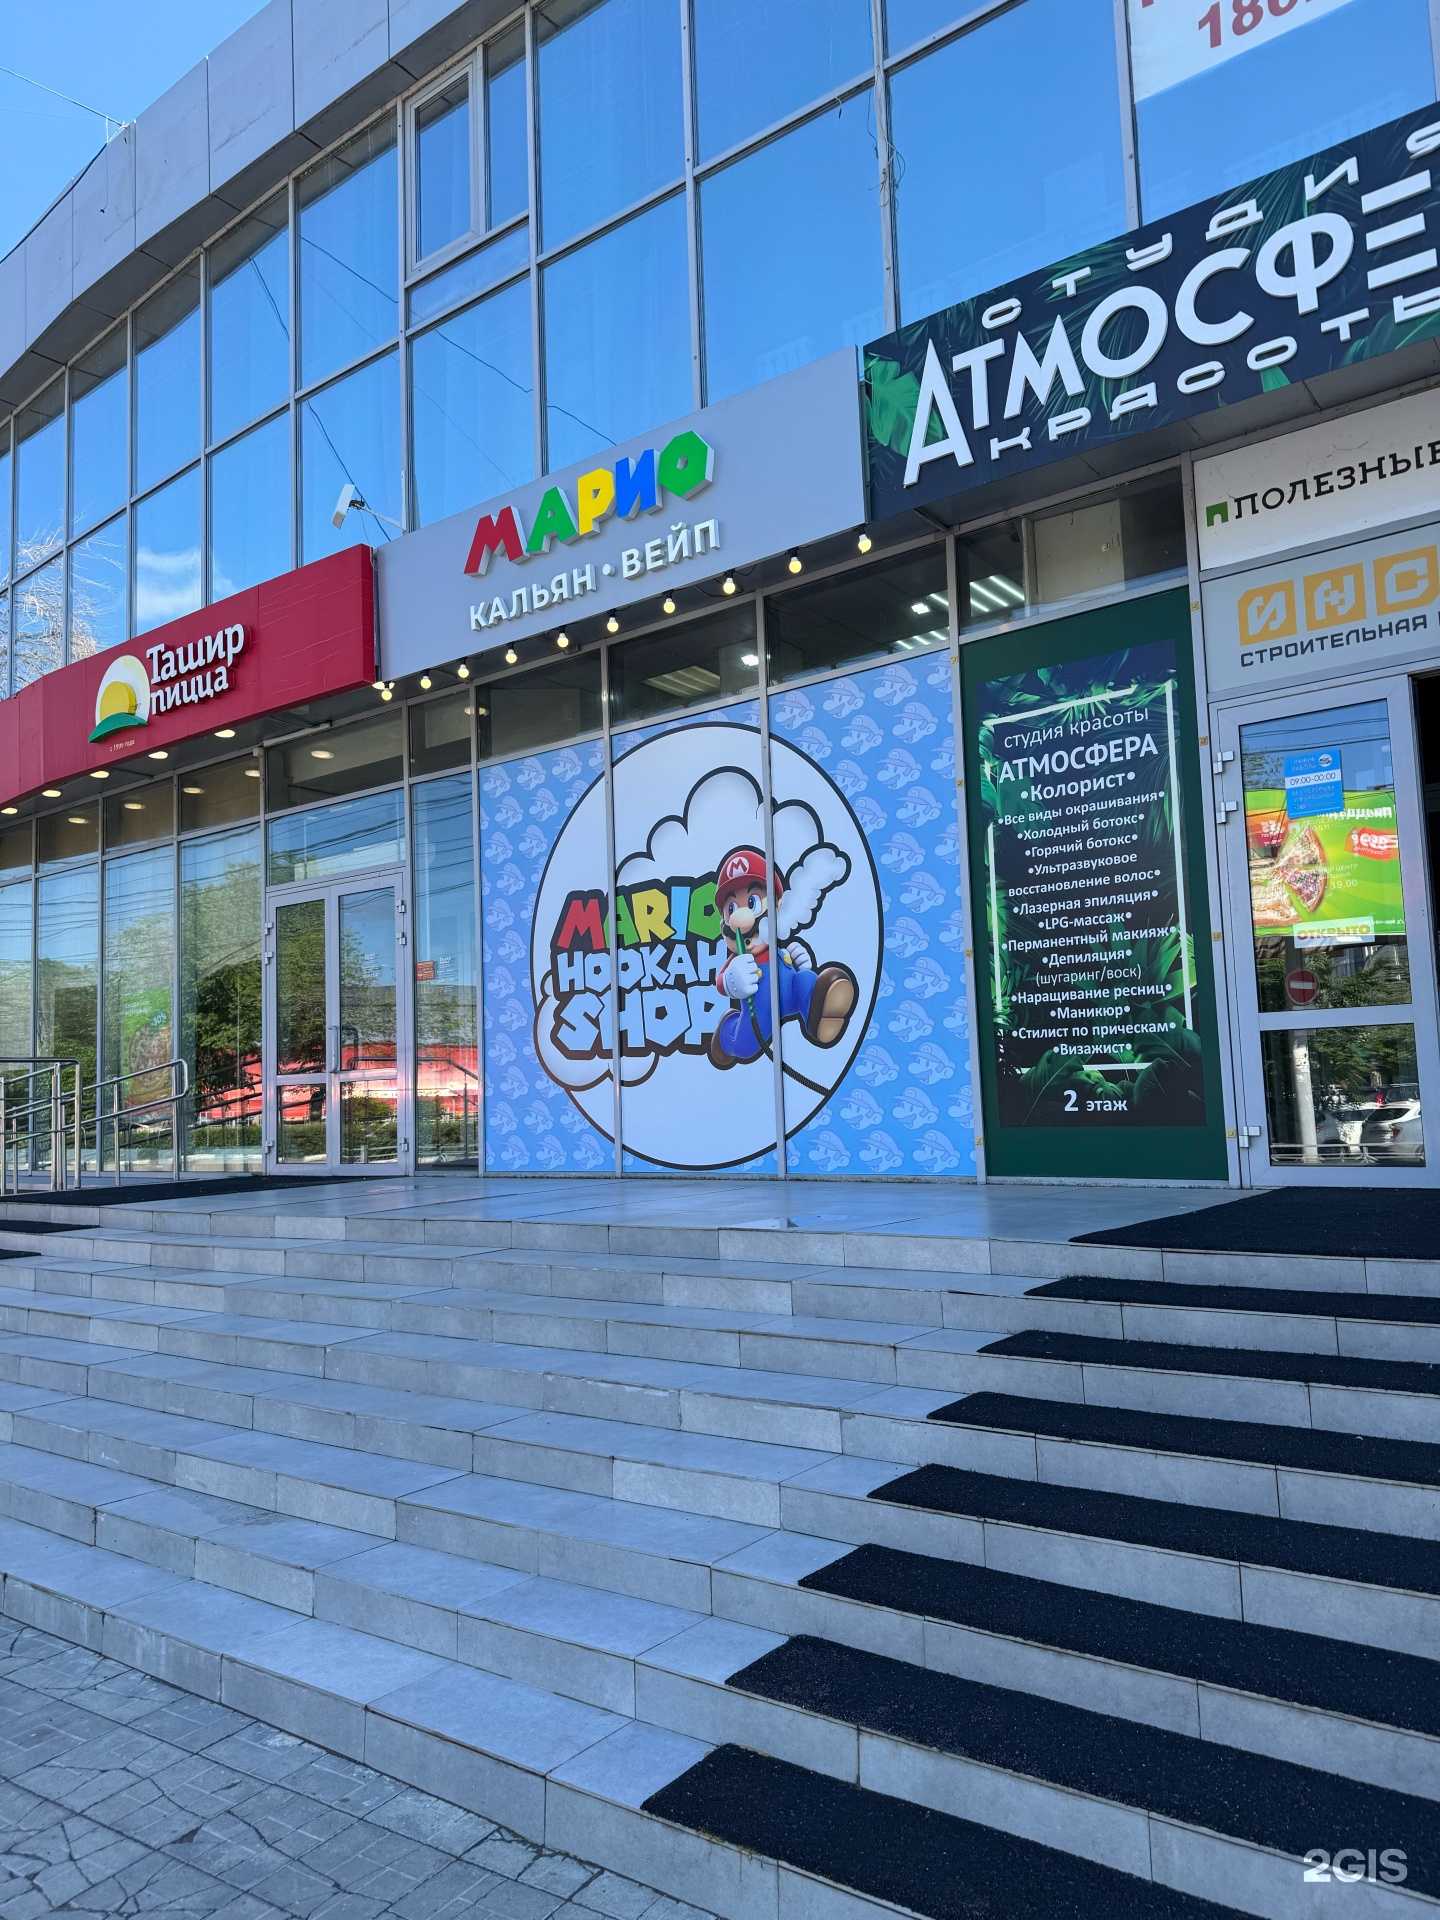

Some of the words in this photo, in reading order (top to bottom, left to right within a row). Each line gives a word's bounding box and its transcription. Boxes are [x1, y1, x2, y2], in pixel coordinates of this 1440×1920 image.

[464, 431, 714, 577] МАРИО
[469, 563, 597, 631] КАЛЬЯН
[622, 519, 720, 580] ВЕЙП
[146, 623, 245, 684] Ташир
[1240, 614, 1427, 667] СТРОИТЕЛЬНАЯ
[150, 665, 229, 715] пицца
[1004, 725, 1063, 749] студия
[1070, 707, 1149, 737] красоты
[999, 733, 1158, 784] АТМОСФЕРА
[1031, 773, 1125, 801] Колорист
[1004, 813, 1025, 825] Все
[1029, 809, 1062, 824] виды
[1066, 791, 1158, 815] окрашивания
[1023, 820, 1089, 840] Холодный
[1093, 814, 1138, 830] ботокс
[1031, 841, 1083, 859] Горячий
[1087, 834, 1131, 850] ботокс
[1035, 853, 1138, 876] Ультразвуковое
[1008, 876, 1111, 897] восстановление
[1115, 870, 1154, 884] волос
[557, 881, 721, 950] MARIO
[1019, 898, 1081, 916] Лазерная
[1084, 890, 1152, 910] эпиляция
[1045, 912, 1126, 931] LPG-массаж
[1008, 933, 1108, 953] Перманентный
[1112, 926, 1170, 943] макияж
[557, 938, 728, 993] HOOKAH
[1048, 951, 1125, 969] Депиляция
[1035, 963, 1142, 988] (шугаринг/воск)
[1017, 986, 1110, 1006] Наращивание
[1114, 984, 1165, 1000] ресниц
[556, 984, 731, 1051] SHOP
[1057, 1004, 1123, 1022] Маникюр
[1018, 1024, 1068, 1040] Стилист
[1072, 1026, 1088, 1038] по
[1092, 1021, 1169, 1040] прическам
[1060, 1041, 1125, 1056] Визажист
[1063, 1089, 1079, 1112] 2
[1086, 1098, 1128, 1112] этаж
